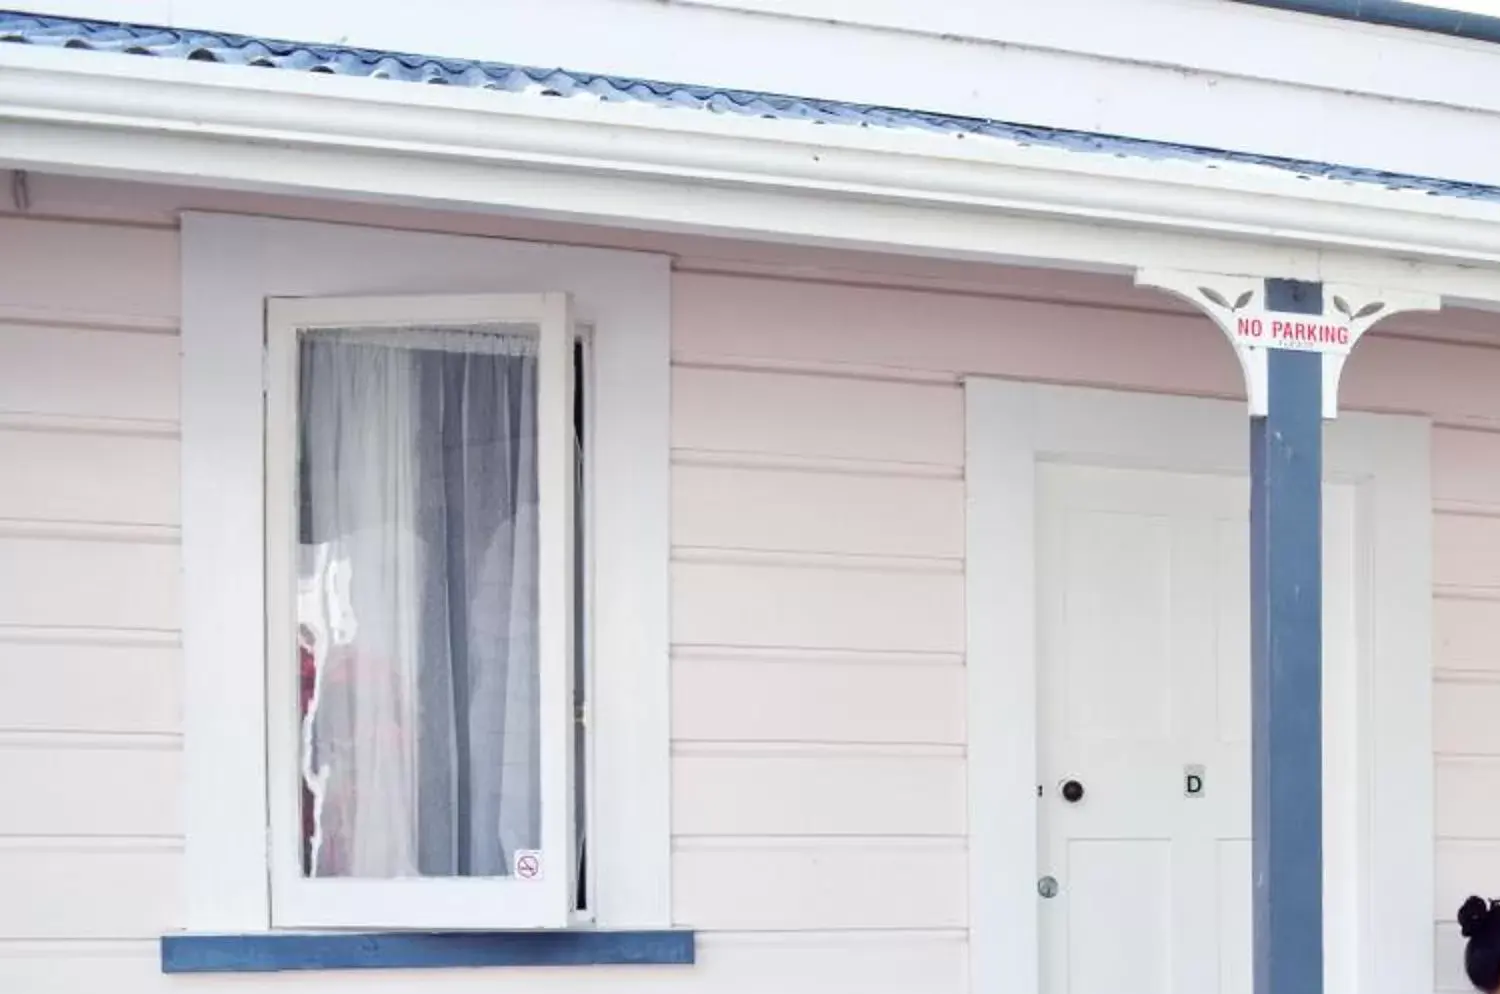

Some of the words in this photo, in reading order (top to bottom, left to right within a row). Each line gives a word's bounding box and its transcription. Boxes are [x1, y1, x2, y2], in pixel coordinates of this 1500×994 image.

[1238, 318, 1262, 337] NO
[1272, 321, 1349, 345] PARKING
[1187, 775, 1202, 793] D
